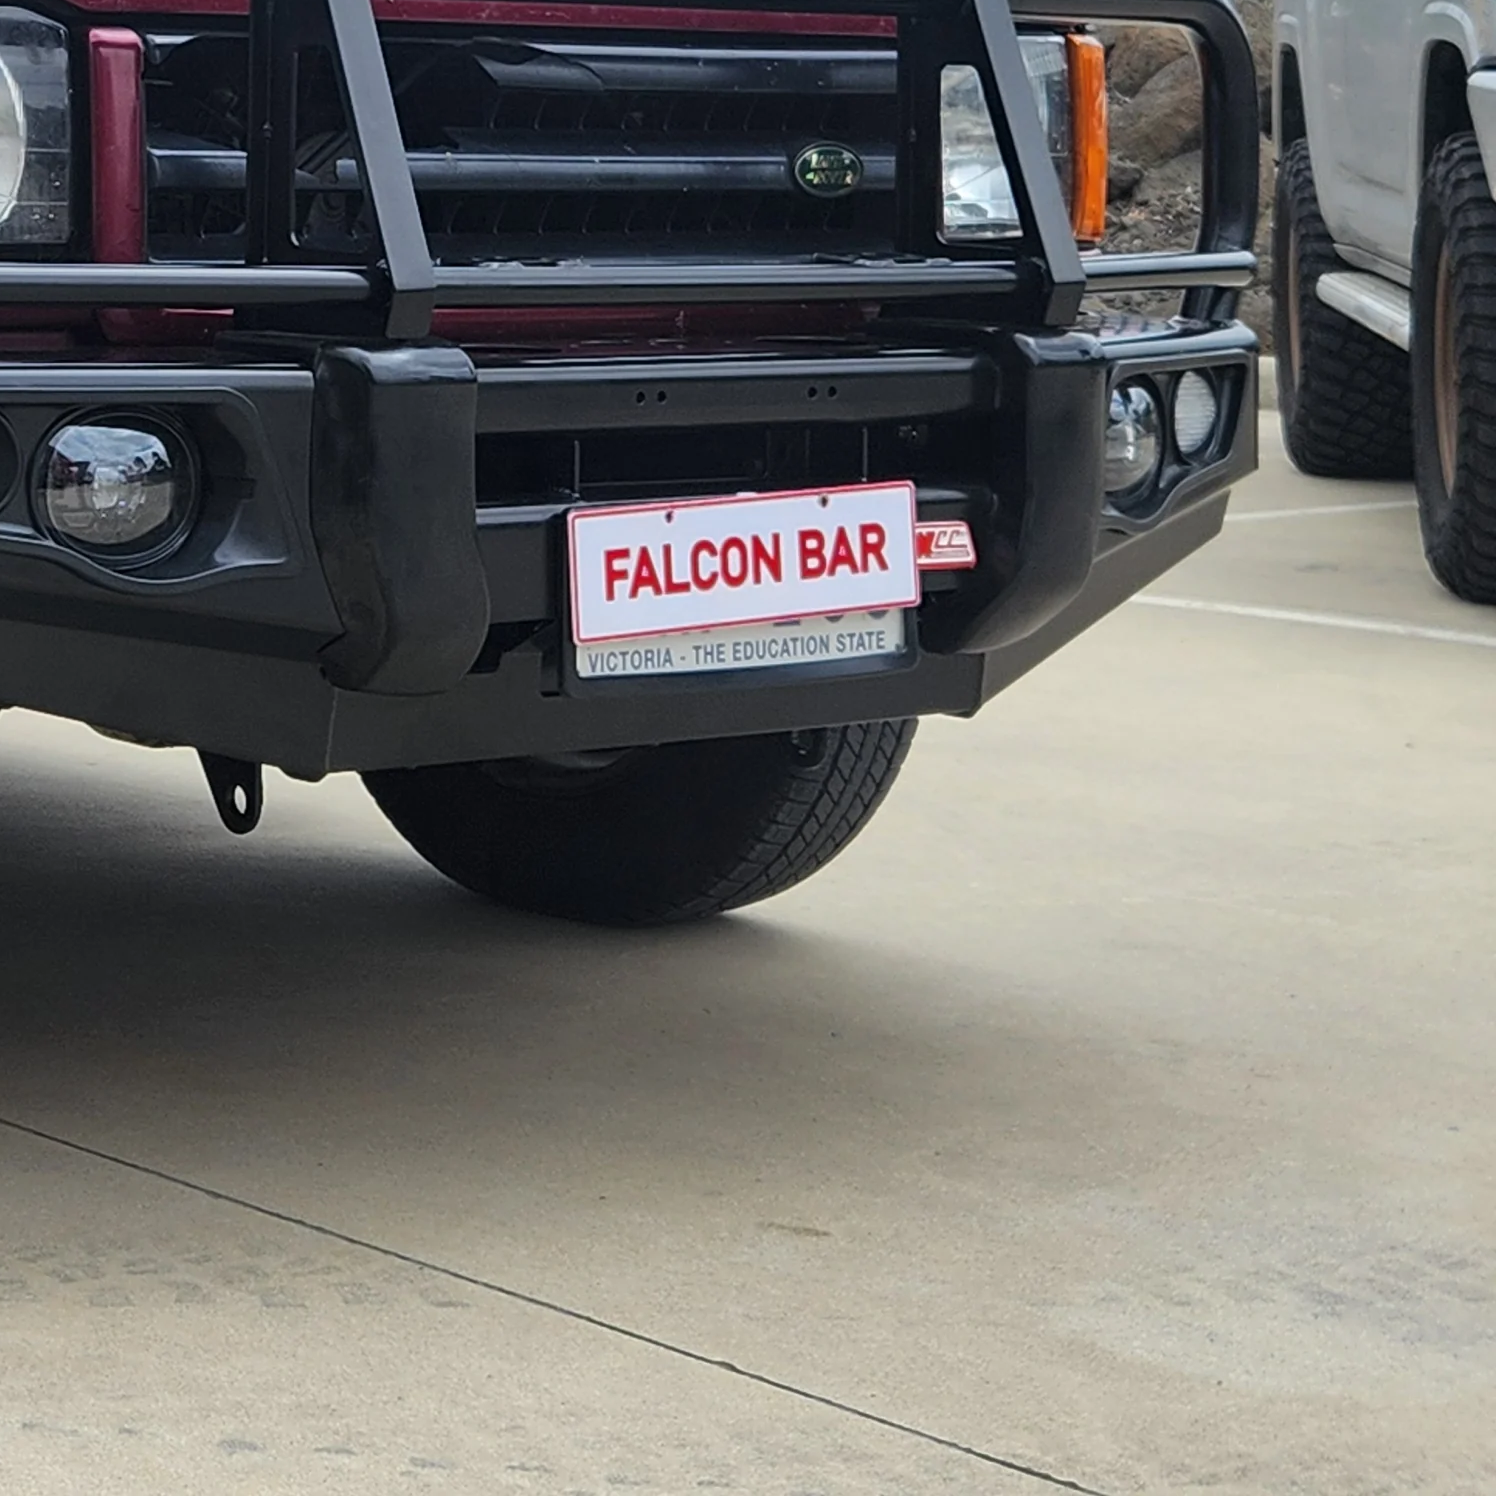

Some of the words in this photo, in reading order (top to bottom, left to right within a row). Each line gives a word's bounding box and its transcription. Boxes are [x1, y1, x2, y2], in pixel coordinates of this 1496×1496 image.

[604, 532, 782, 601] FALCON
[798, 523, 889, 580] BAR
[588, 648, 673, 673] VICTORIA
[693, 643, 726, 665] THE
[732, 636, 830, 661] EDUCATION
[836, 630, 886, 651] STATE
